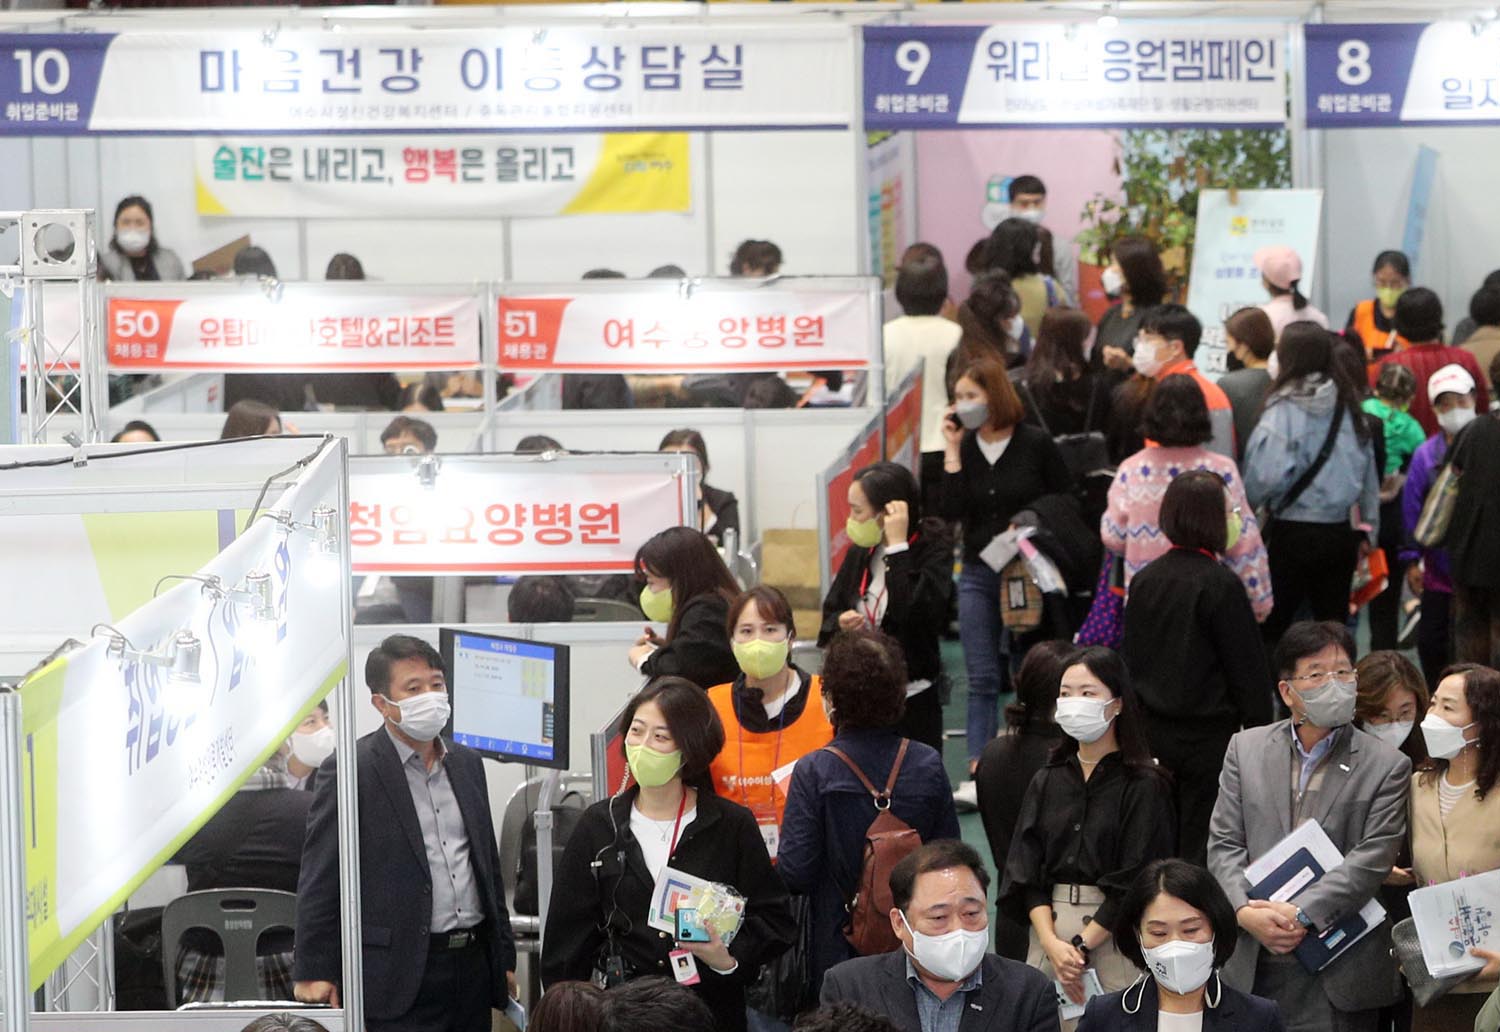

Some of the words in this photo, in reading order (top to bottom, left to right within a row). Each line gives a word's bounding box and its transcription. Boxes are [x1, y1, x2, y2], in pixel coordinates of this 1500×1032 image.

[12, 48, 70, 95] 10
[199, 48, 423, 94] 마음건강
[460, 44, 744, 93] 이동상담실
[895, 40, 931, 86] 9
[987, 39, 1089, 82] 워라
[1103, 39, 1276, 83] 응원캠페인
[1337, 39, 1372, 86] 8
[6, 104, 79, 121] 취업준비관
[212, 145, 293, 182] 술잔은
[303, 147, 393, 184] 내리고,
[402, 147, 484, 183] 행복은
[495, 147, 575, 182] 올리고
[114, 310, 159, 338] 50
[200, 316, 455, 347] 유탑마호텔&리조트
[504, 311, 538, 338] 51
